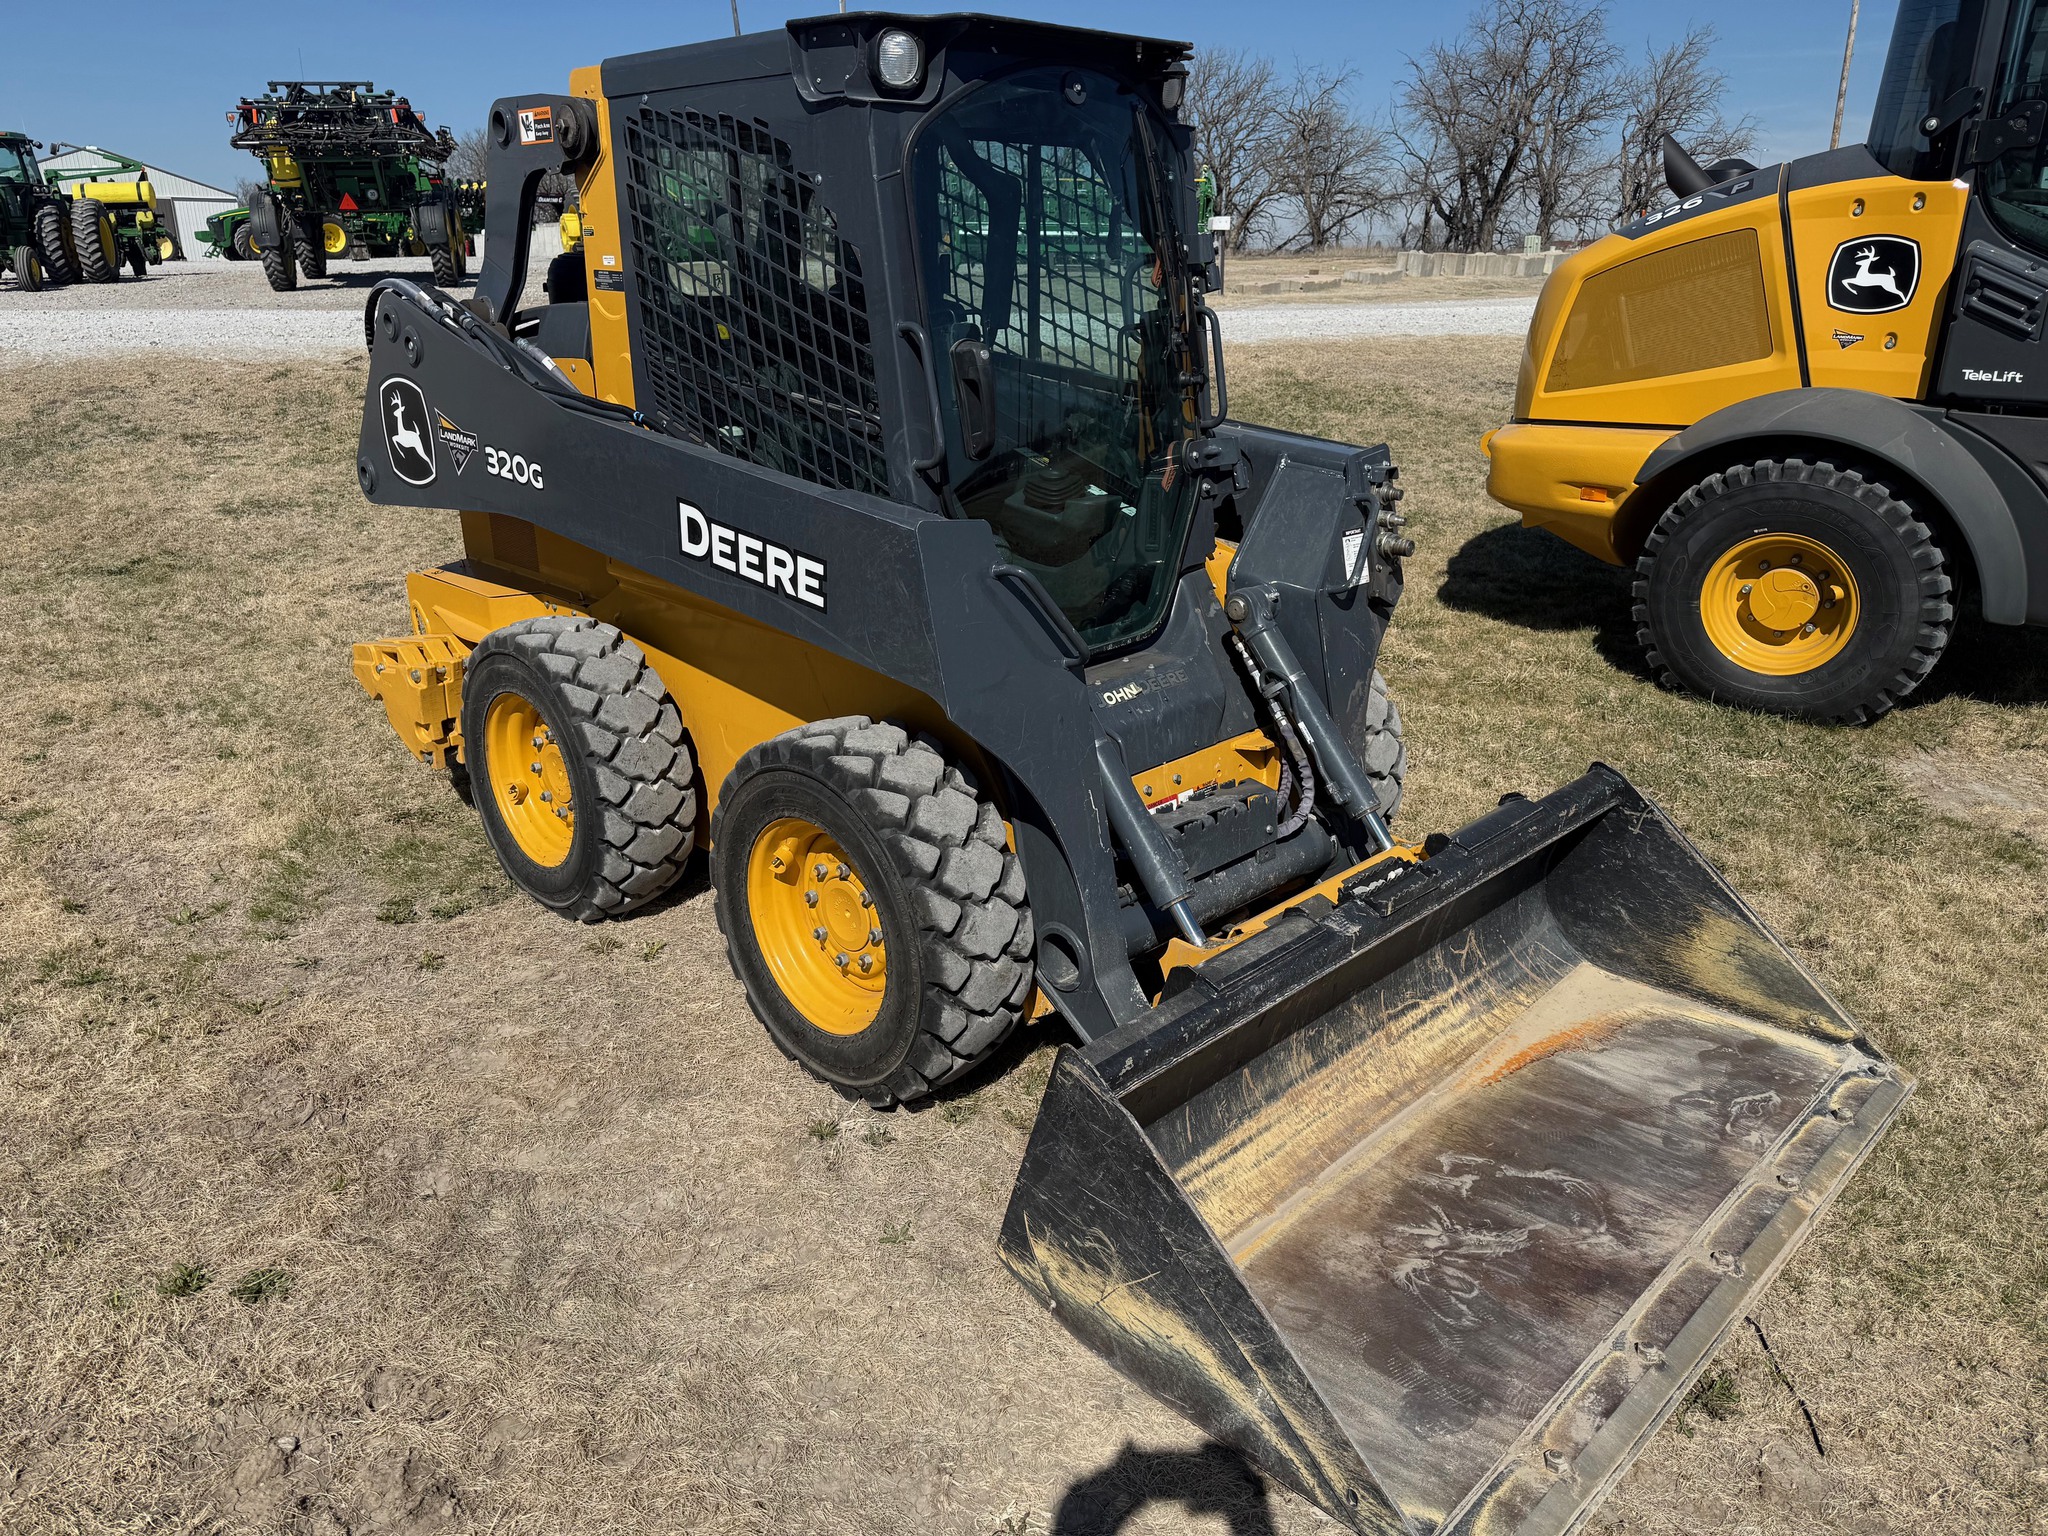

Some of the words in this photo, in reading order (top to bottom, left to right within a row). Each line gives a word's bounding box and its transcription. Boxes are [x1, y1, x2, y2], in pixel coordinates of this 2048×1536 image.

[1644, 195, 1703, 226] 326
[1730, 181, 1750, 195] P
[449, 441, 470, 452] WORKSITE
[484, 446, 544, 489] 320G
[679, 502, 825, 608] DEERE
